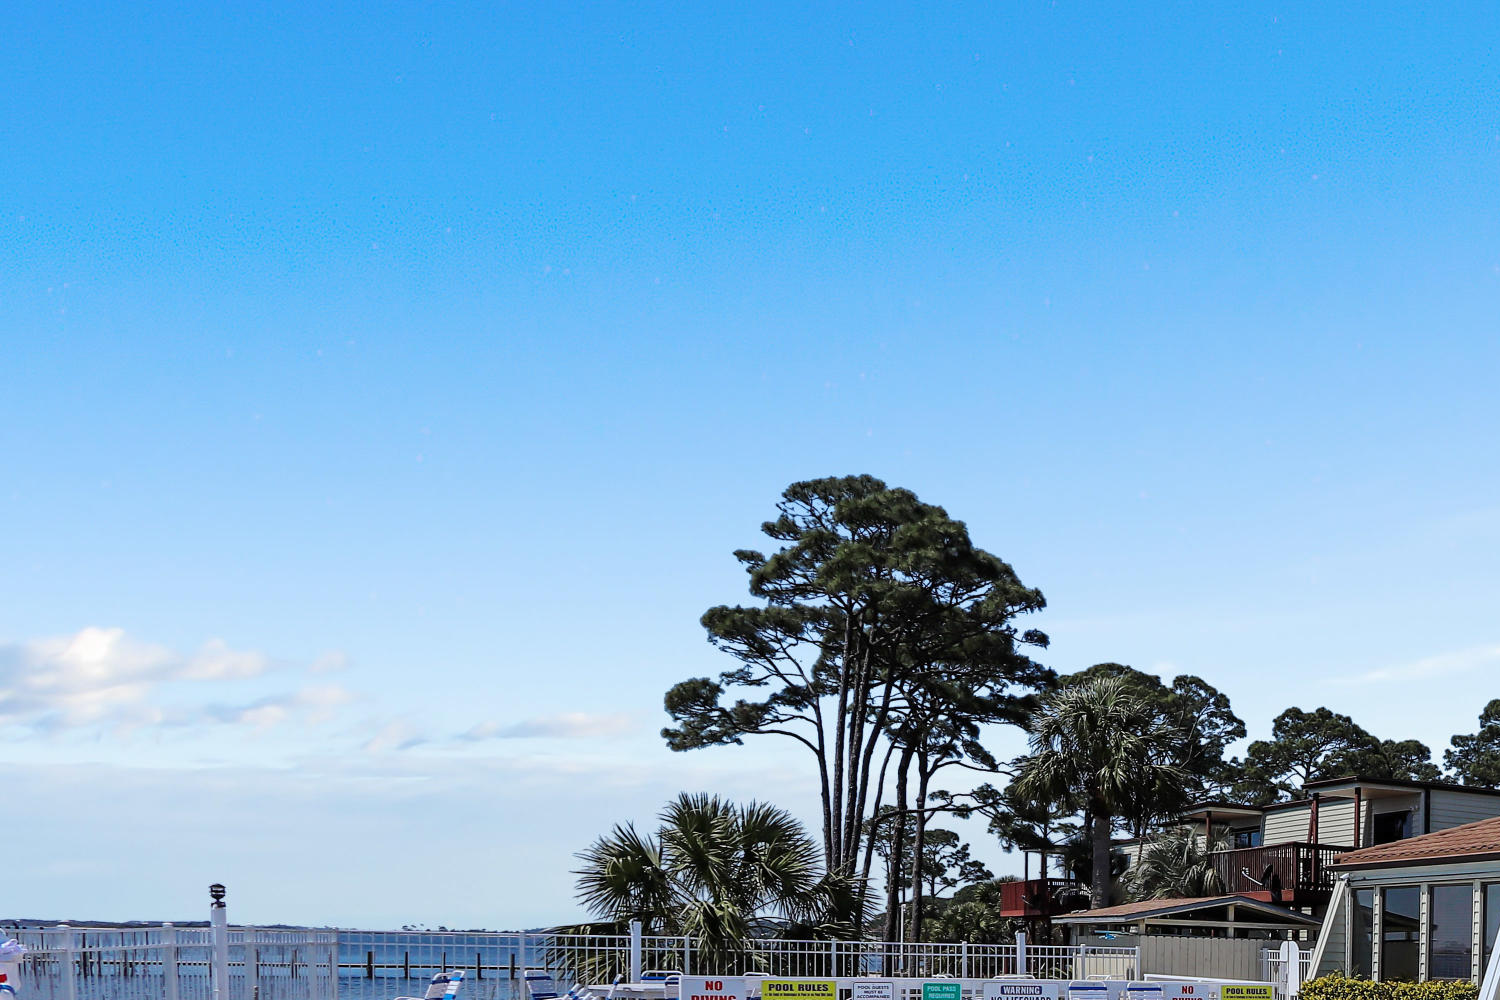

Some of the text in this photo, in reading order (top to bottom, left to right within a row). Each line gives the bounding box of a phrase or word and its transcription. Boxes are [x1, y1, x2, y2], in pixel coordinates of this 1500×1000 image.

[705, 980, 723, 991] NO
[768, 983, 829, 992] POOL RULES
[1181, 985, 1194, 994] NO
[1003, 986, 1040, 995] WARNING
